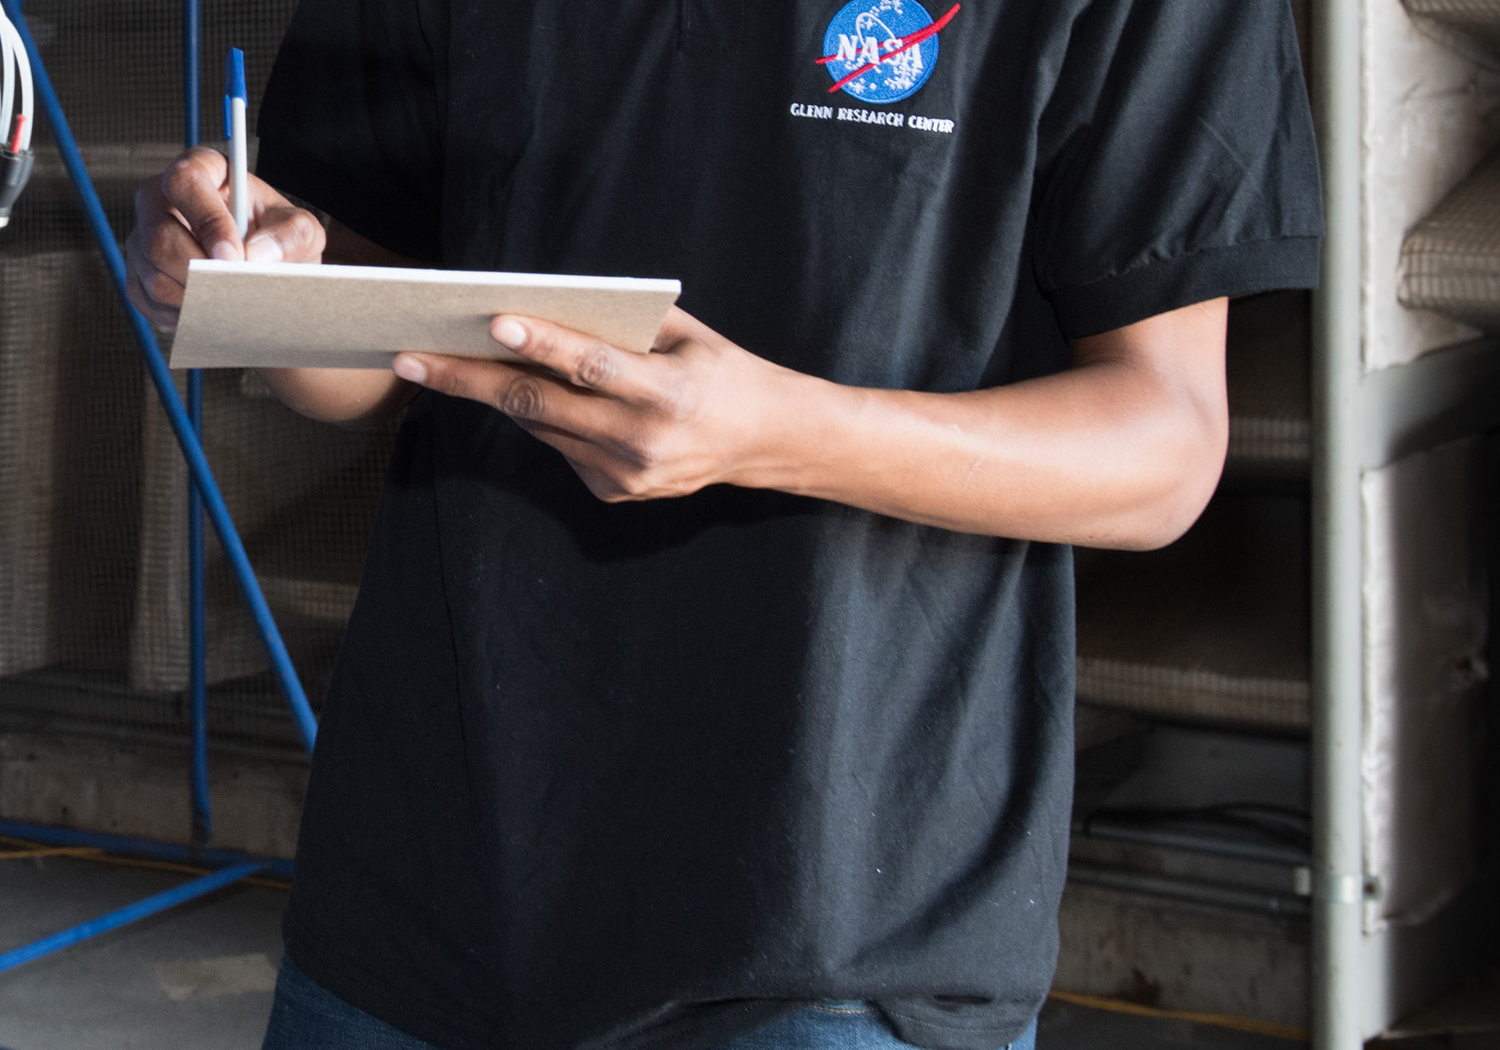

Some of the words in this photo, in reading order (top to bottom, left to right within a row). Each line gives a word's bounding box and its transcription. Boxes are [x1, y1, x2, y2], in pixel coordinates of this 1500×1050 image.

[835, 33, 923, 69] NASA
[790, 102, 833, 119] GLENN
[837, 107, 904, 126] RESEARCH
[908, 115, 955, 133] CENTER
